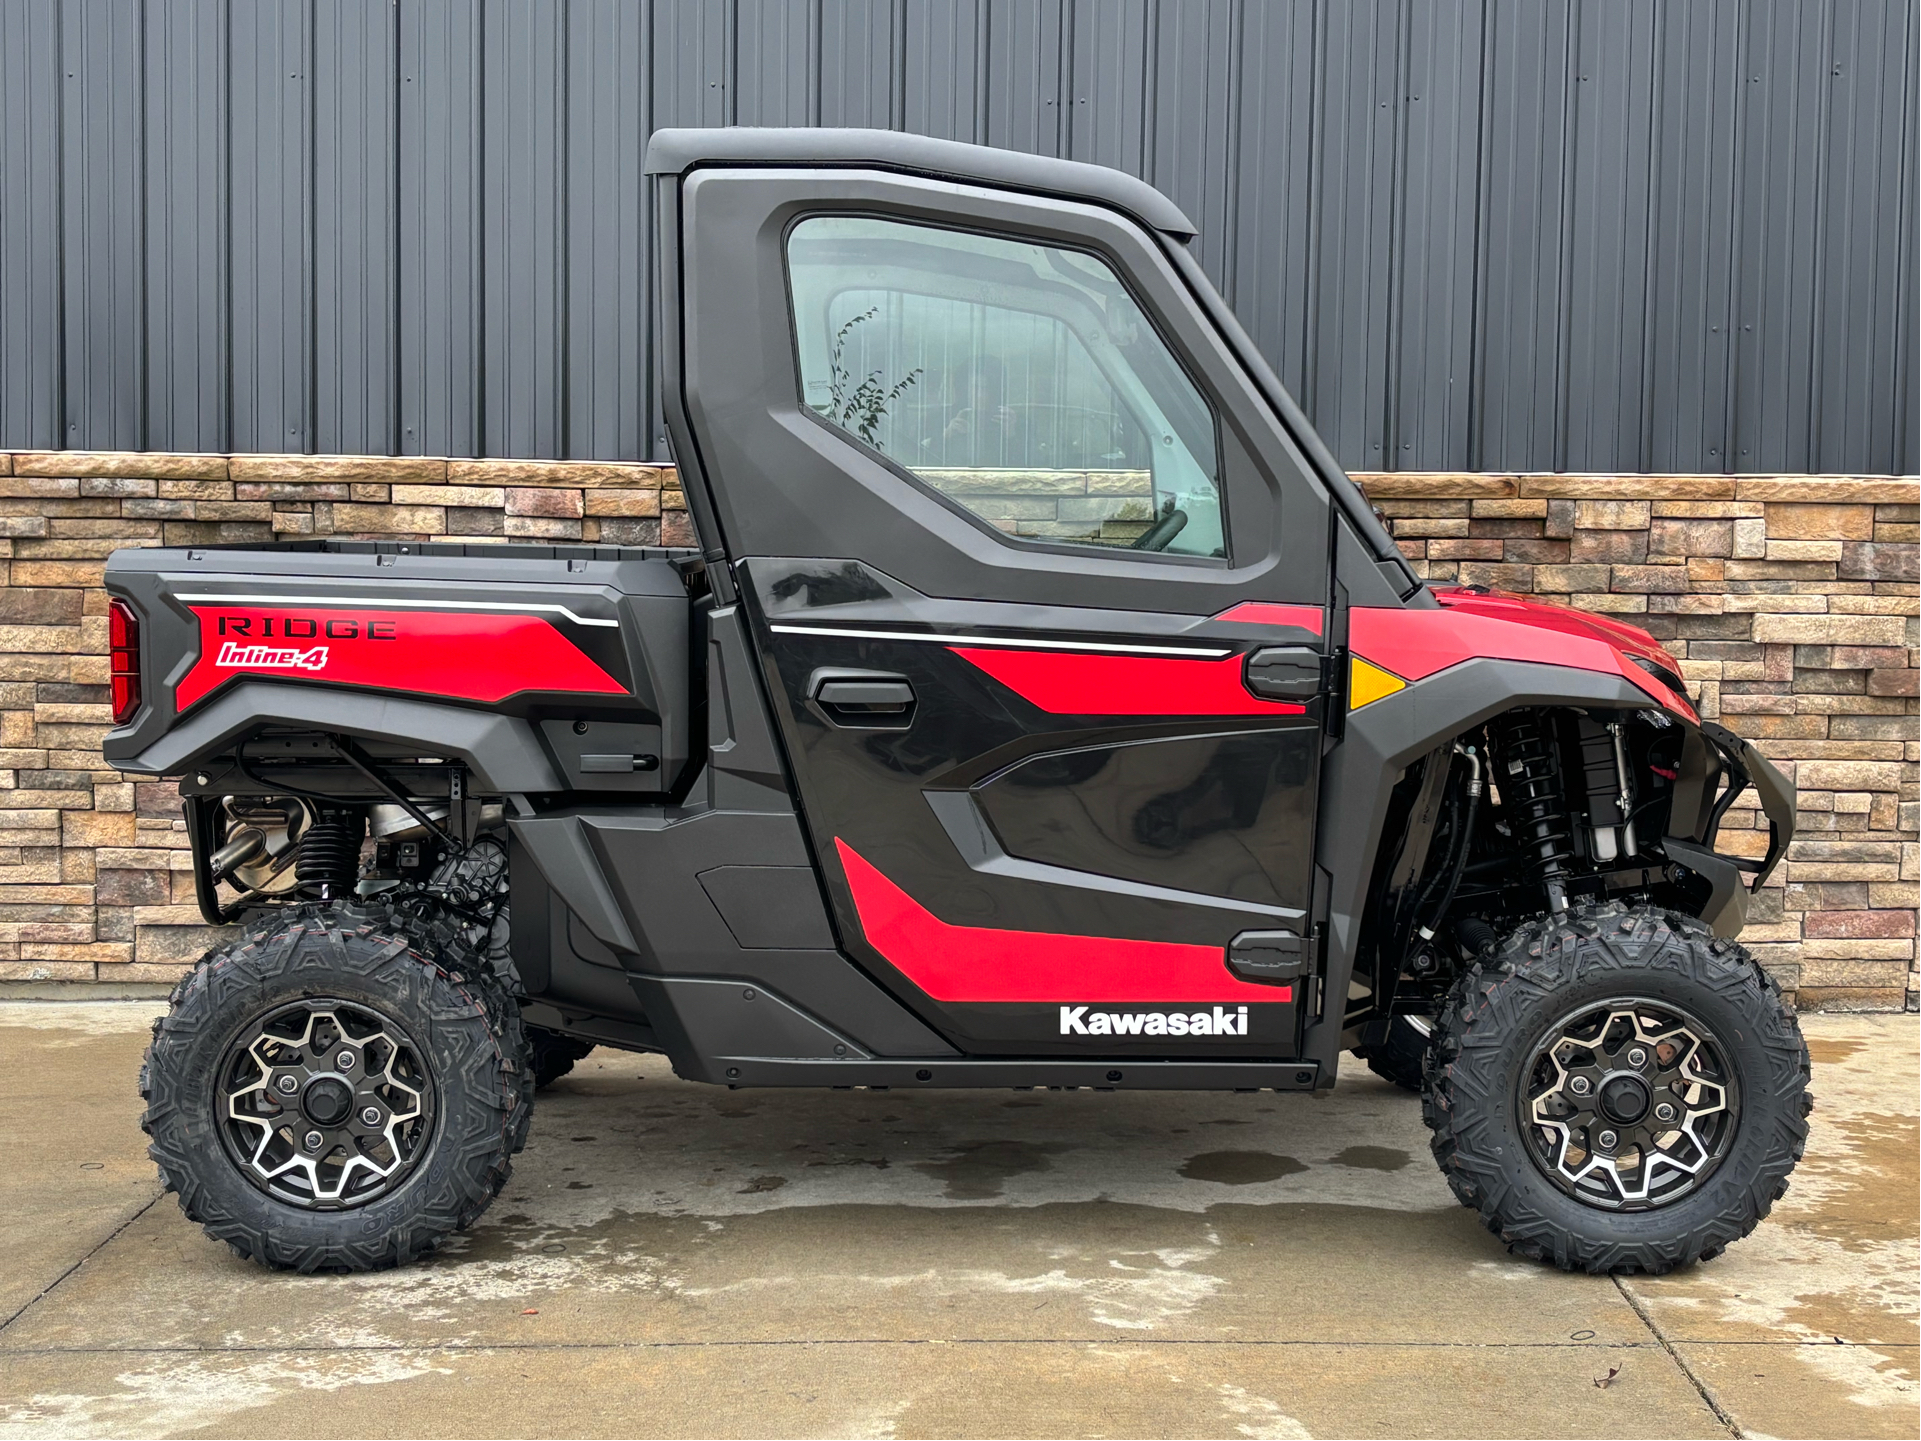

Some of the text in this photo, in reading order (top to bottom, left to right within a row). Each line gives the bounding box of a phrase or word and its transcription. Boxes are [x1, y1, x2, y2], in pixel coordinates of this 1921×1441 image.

[219, 617, 396, 640] RIDGE
[216, 641, 329, 670] Inline-4
[1060, 1007, 1249, 1036] Kawasaki
[1496, 1007, 1543, 1092] DURO
[360, 1161, 447, 1234] DURO
